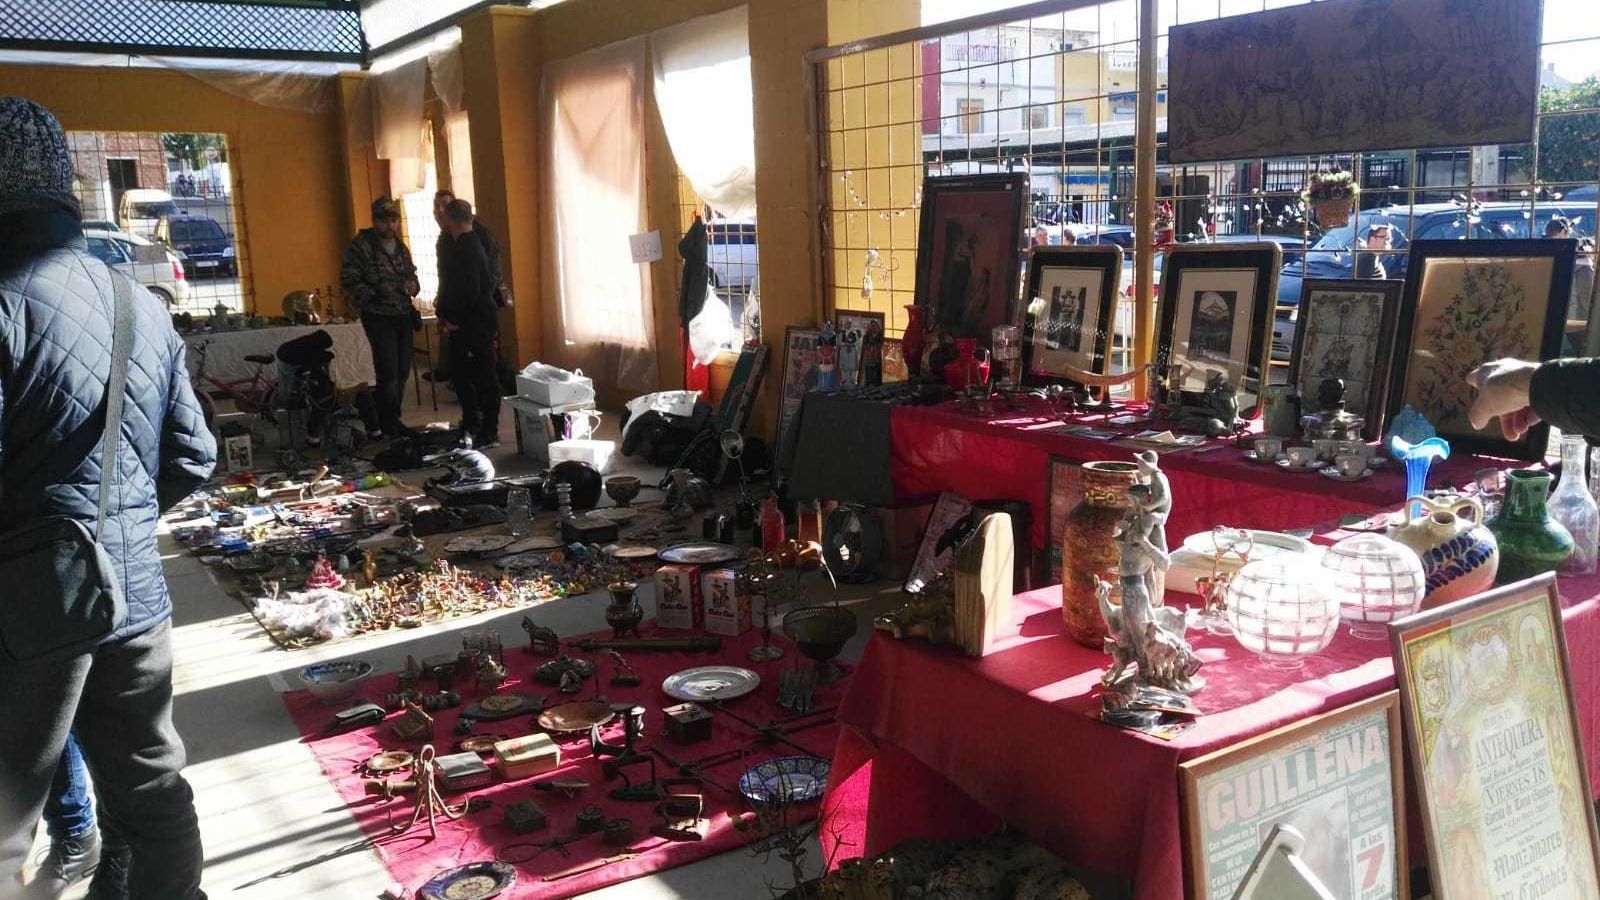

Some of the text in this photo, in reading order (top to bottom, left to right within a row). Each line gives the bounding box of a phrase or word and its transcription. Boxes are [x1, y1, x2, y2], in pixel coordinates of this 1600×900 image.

[1475, 717, 1544, 768] ANTEQUERA
[1206, 725, 1385, 832] GUILLENA
[1532, 764, 1546, 783] 18
[1368, 831, 1383, 846] las
[1493, 831, 1562, 880] Manzanares
[1356, 843, 1386, 890] 7
